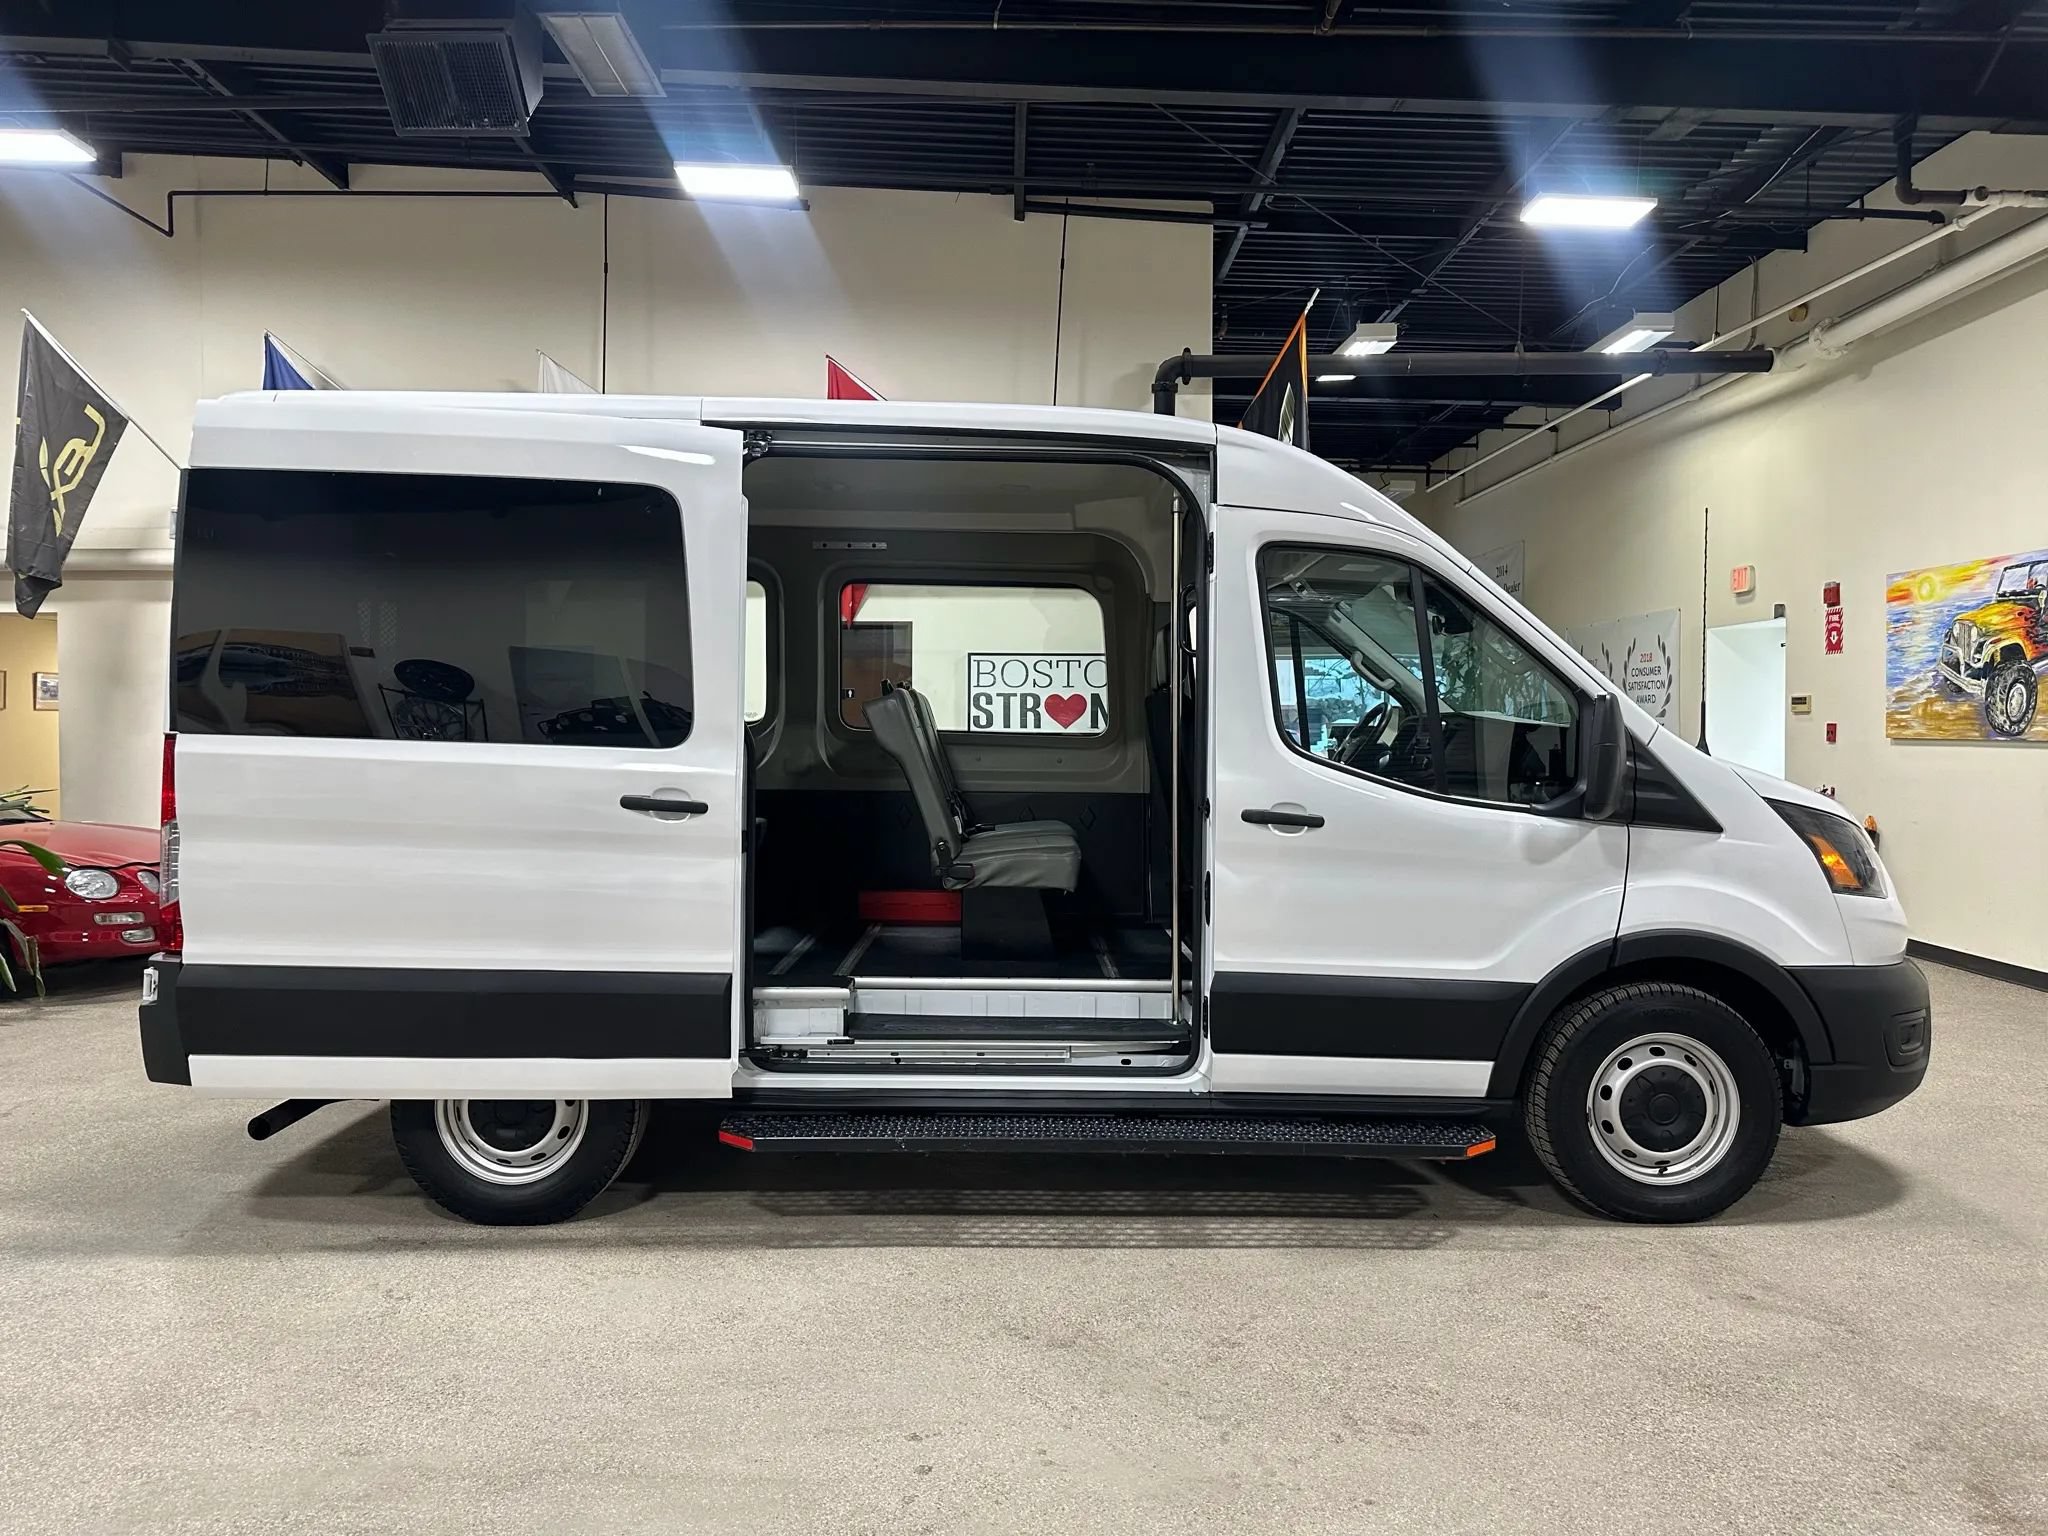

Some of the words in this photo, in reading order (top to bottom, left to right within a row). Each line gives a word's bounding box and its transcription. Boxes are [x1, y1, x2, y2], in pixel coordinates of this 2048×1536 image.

[1828, 614, 1840, 622] FIRE
[1640, 652, 1653, 663] 2018
[972, 659, 1108, 688] BOSTO
[1631, 666, 1662, 677] CONSUMER
[1628, 679, 1666, 692] SATISFACTION
[1636, 694, 1657, 704] AWARD
